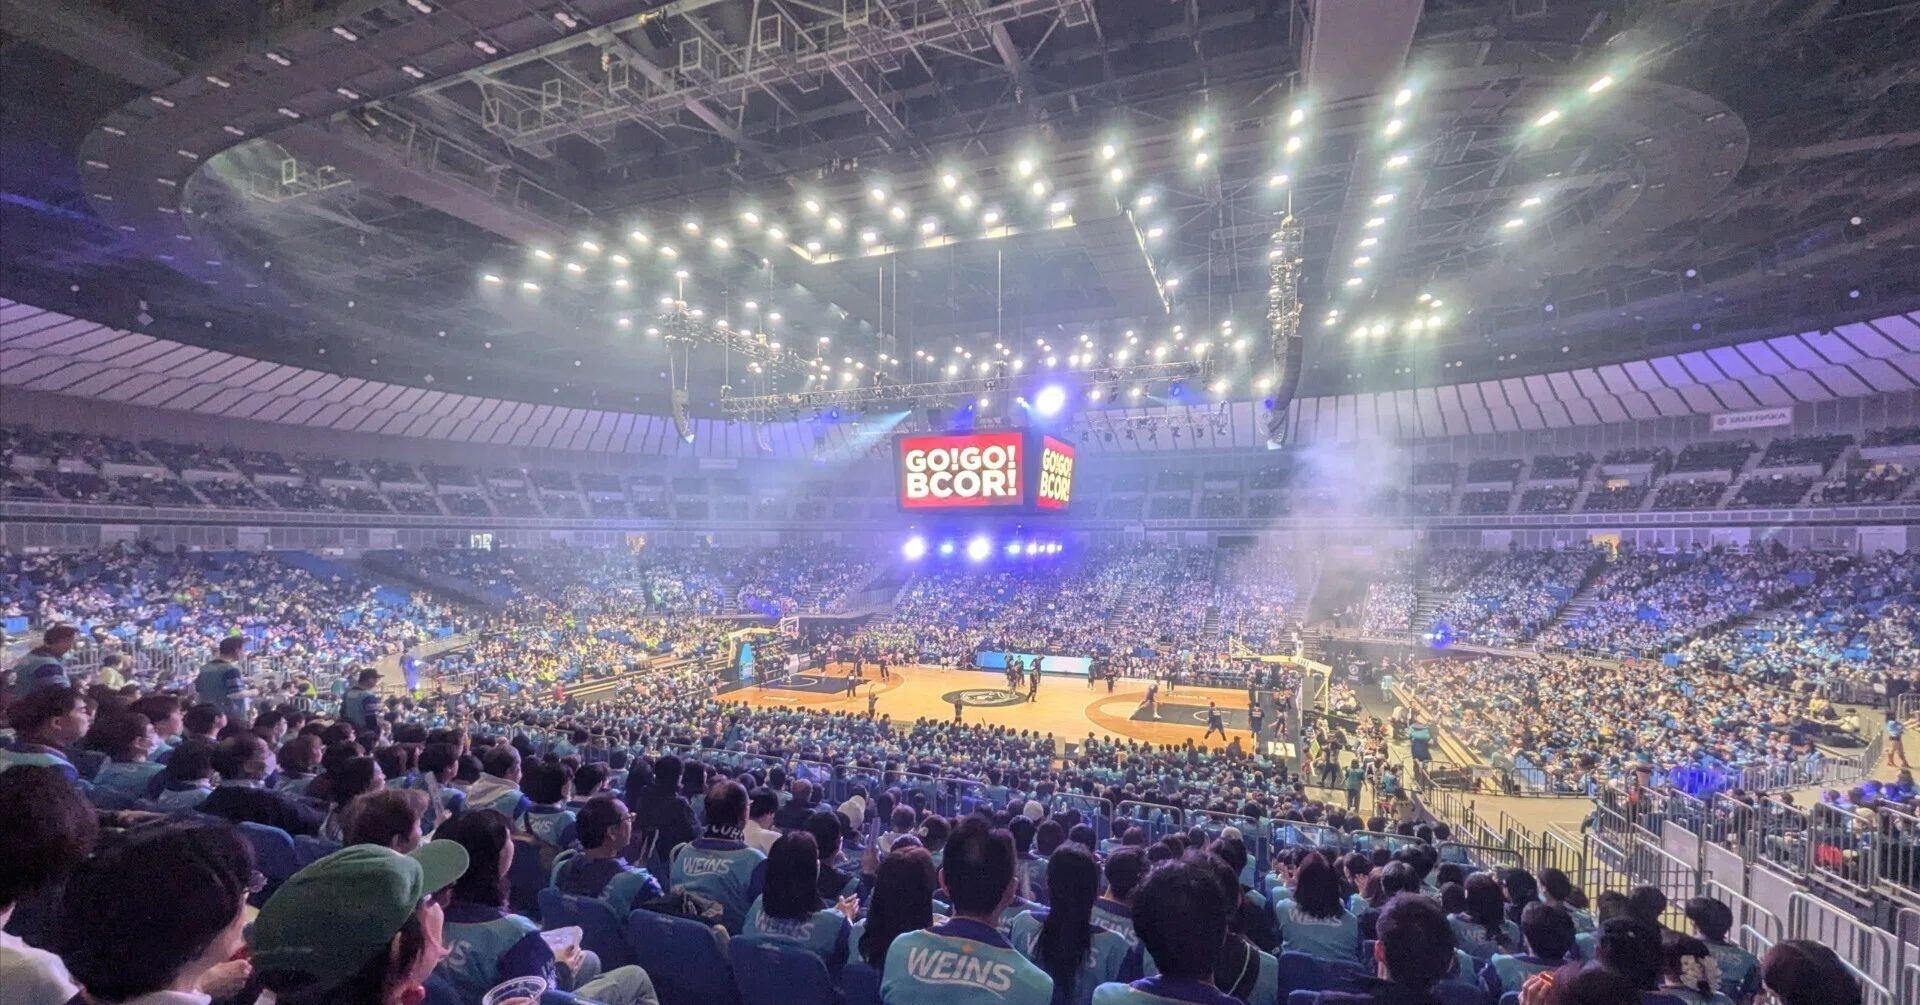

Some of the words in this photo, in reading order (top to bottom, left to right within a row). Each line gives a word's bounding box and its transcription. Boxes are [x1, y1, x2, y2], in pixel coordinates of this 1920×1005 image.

[905, 445, 1016, 472] GO!GO!
[1042, 448, 1073, 477] GO!GO!
[906, 469, 1017, 498] BCOR!
[1039, 470, 1072, 502] BCOR!
[682, 856, 734, 876] WEINS
[907, 946, 1015, 993] WEINS
